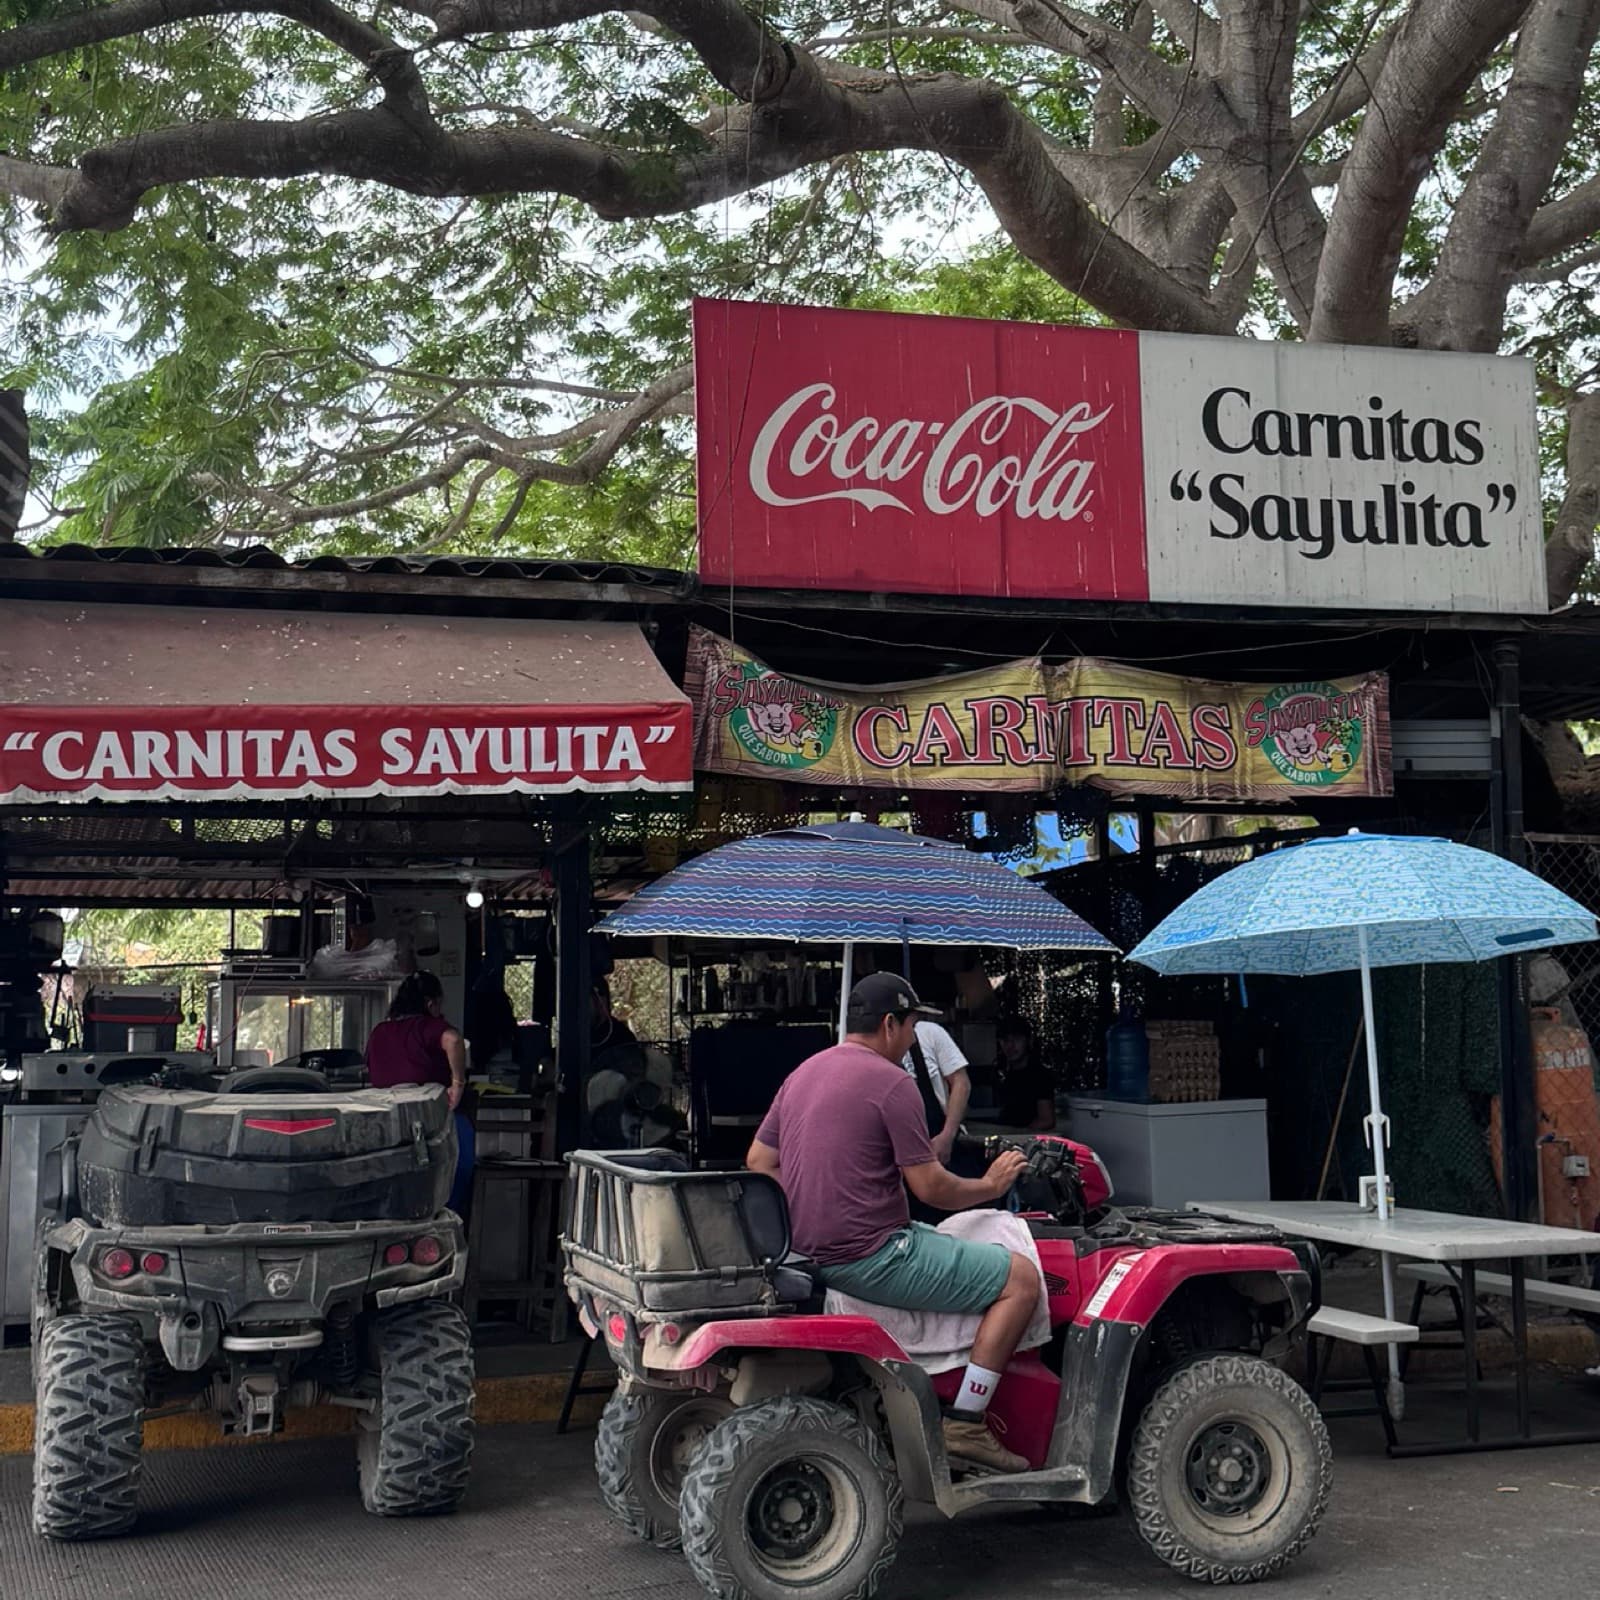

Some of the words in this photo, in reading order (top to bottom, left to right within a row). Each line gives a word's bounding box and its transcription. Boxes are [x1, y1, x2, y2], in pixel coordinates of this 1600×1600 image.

[750, 382, 1114, 521] Coca-Cola
[1202, 382, 1485, 466] Carnitas
[1169, 469, 1517, 560] “Sayulita”
[3, 729, 357, 781] “CARNITAS
[379, 725, 676, 776] SAYULITA”
[738, 723, 758, 746] QUE
[853, 695, 1239, 770] CARNITAS
[1270, 751, 1288, 771] QUE
